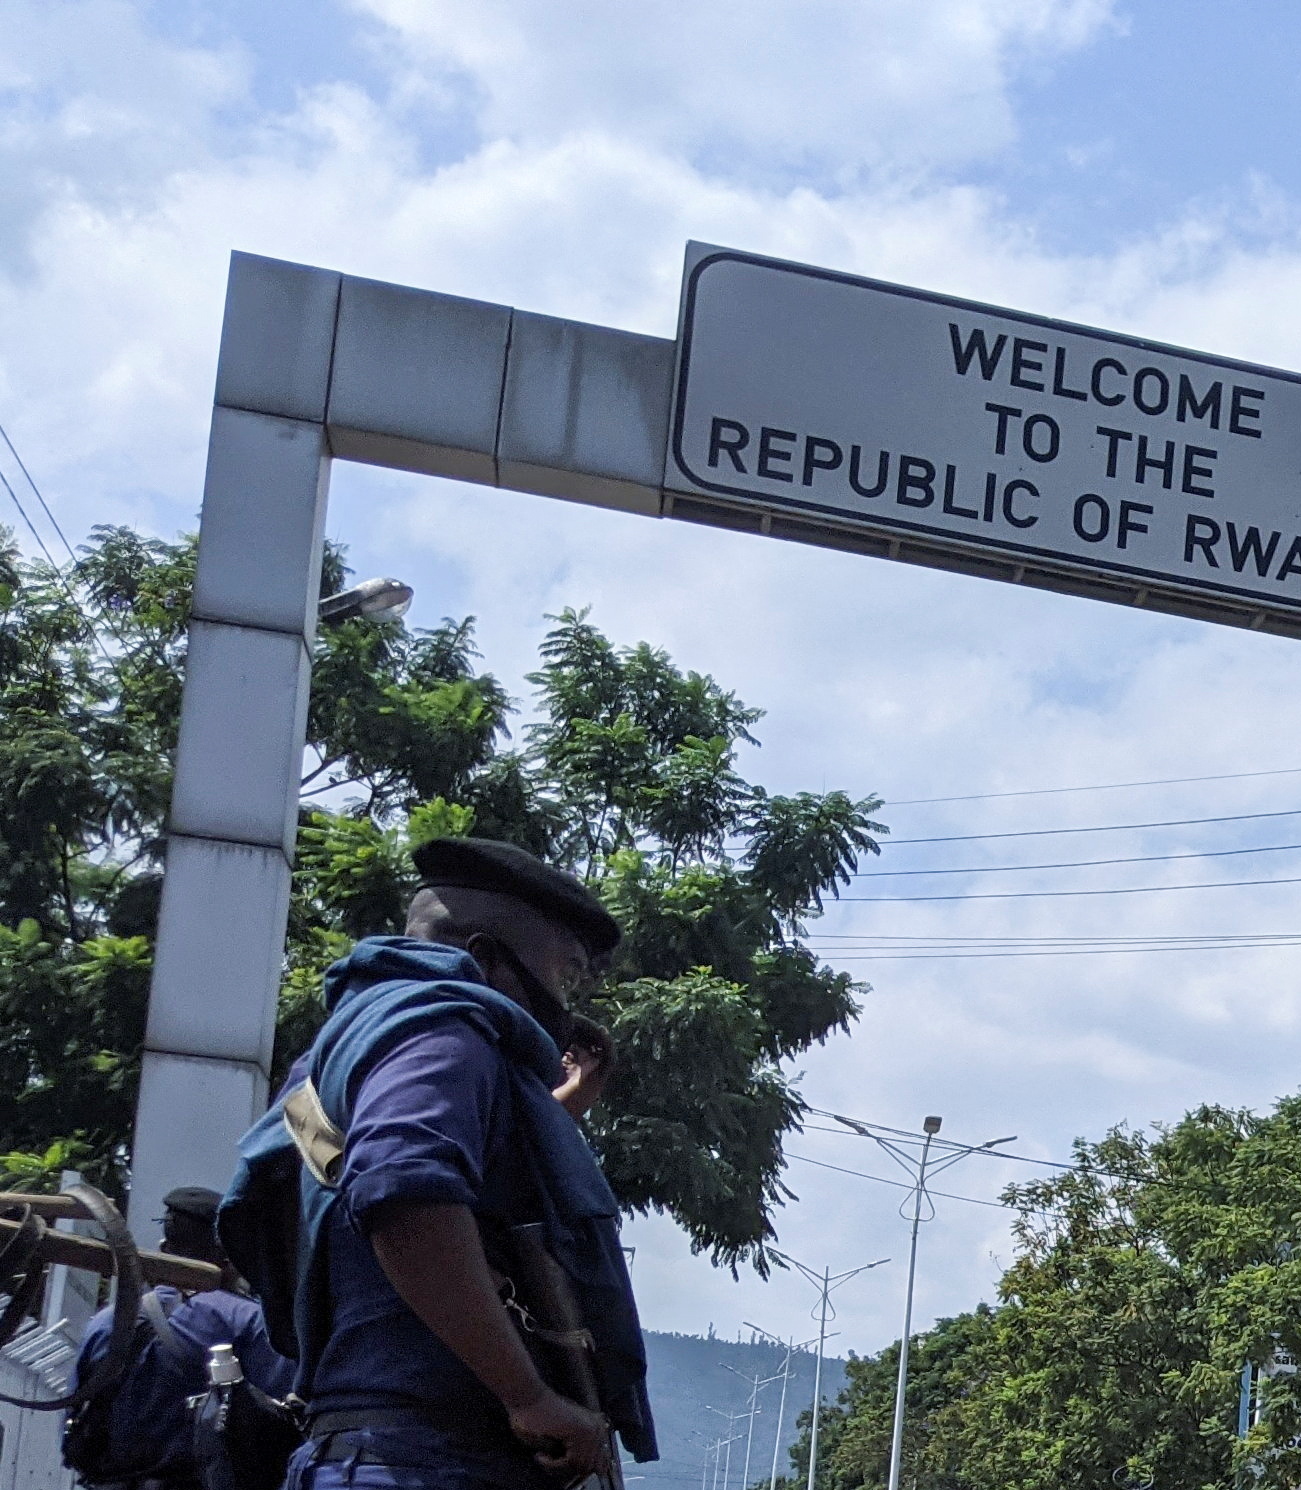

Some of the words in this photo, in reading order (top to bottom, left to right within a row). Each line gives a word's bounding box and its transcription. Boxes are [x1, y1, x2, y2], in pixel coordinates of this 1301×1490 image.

[949, 323, 1266, 440] WELCOME
[707, 416, 1040, 529] REPUBLIC
[1073, 493, 1154, 550] OF
[984, 402, 1060, 463] TO
[1096, 426, 1218, 499] THE
